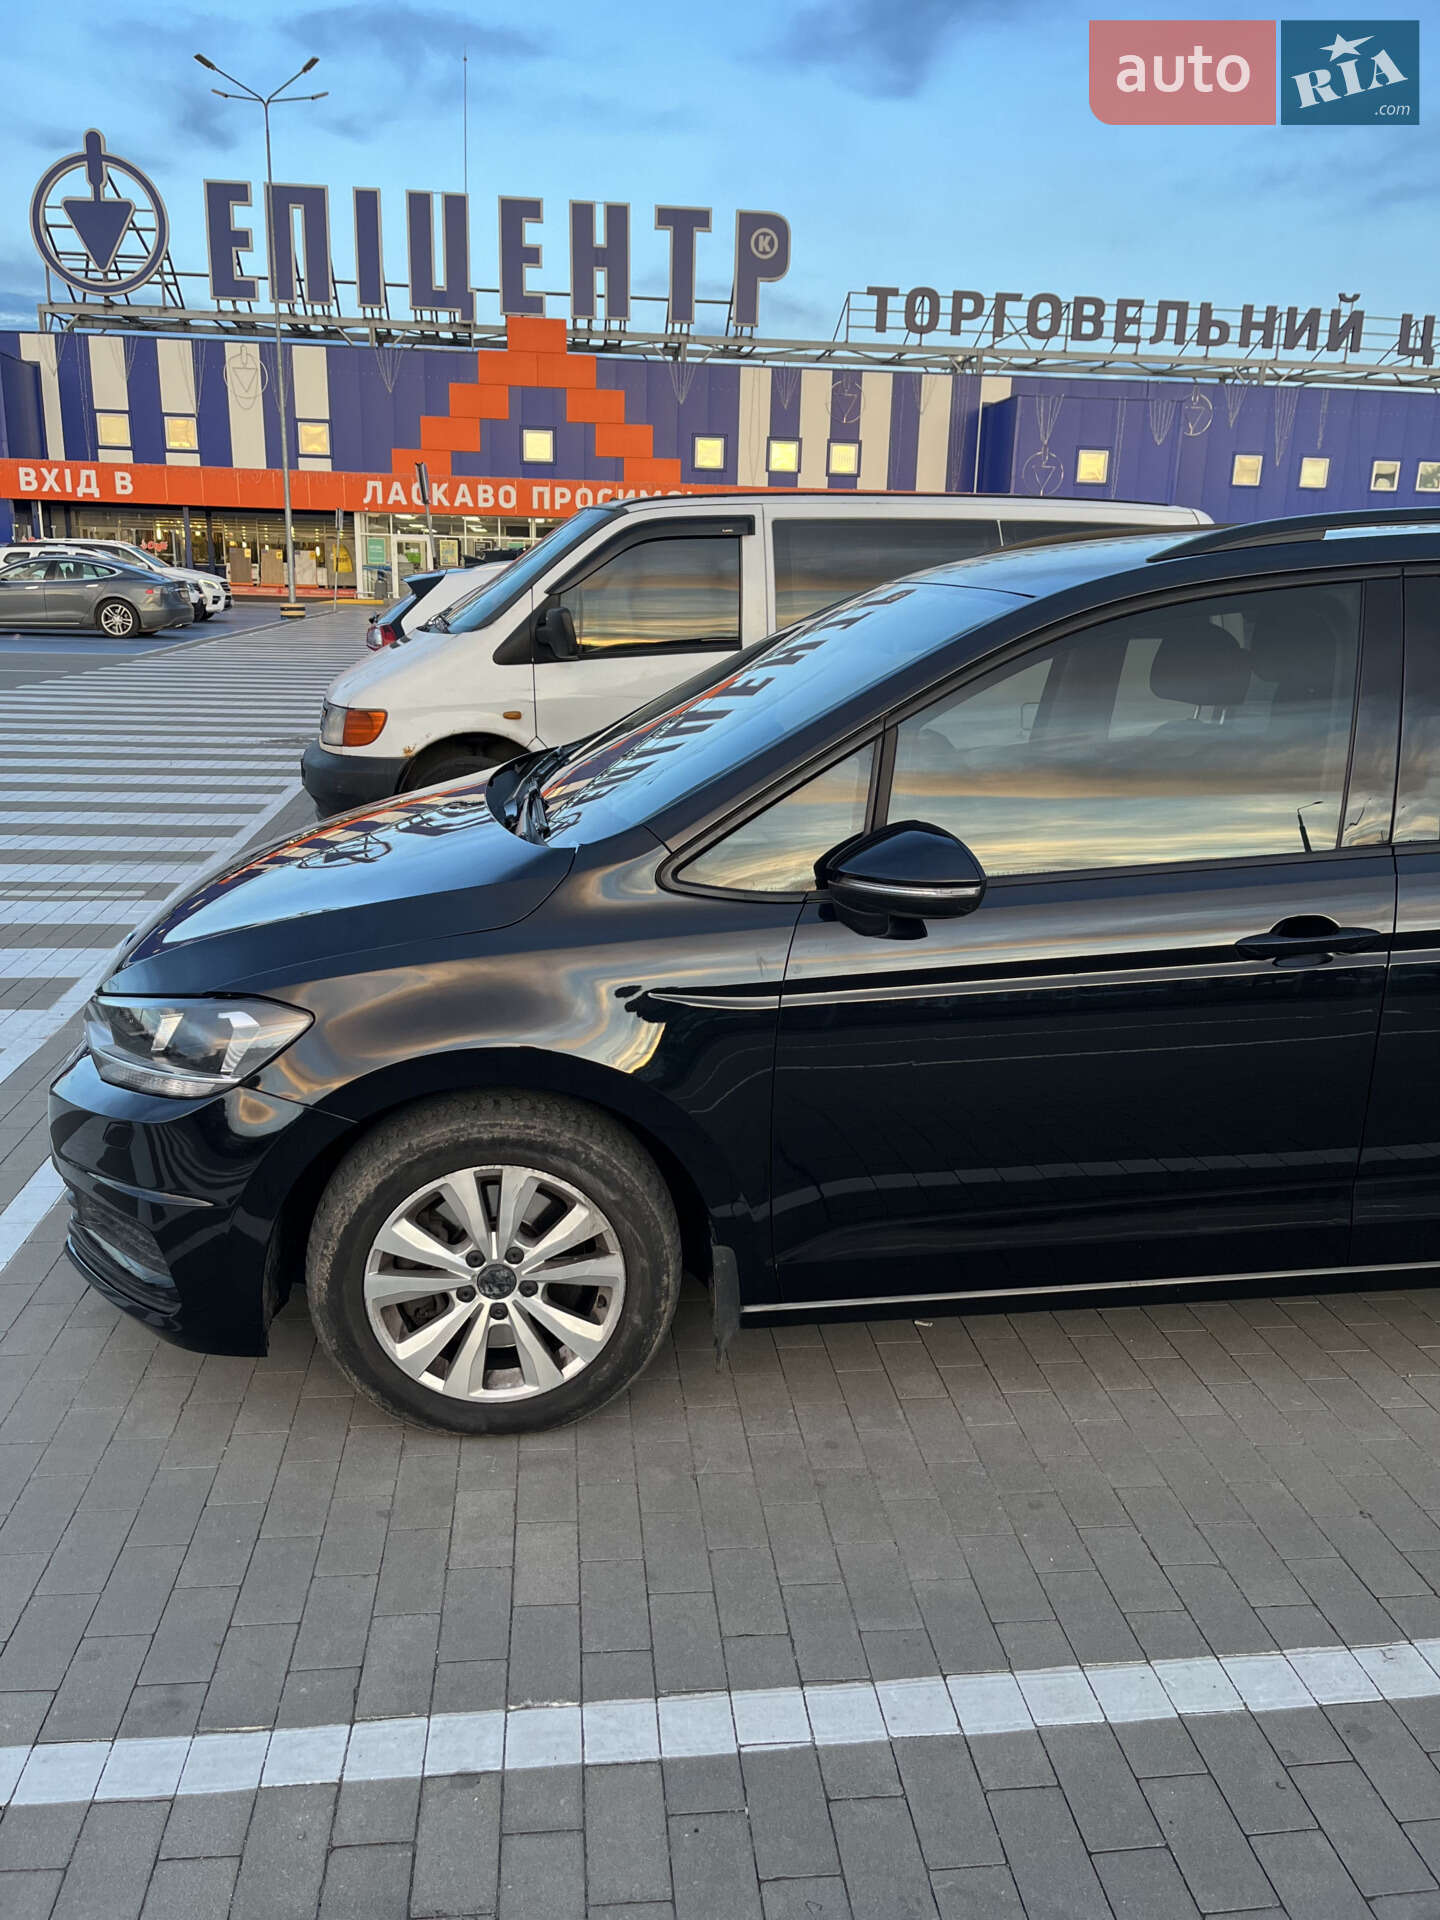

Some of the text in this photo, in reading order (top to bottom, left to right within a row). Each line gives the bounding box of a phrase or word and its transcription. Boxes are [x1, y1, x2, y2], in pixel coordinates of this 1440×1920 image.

[203, 179, 791, 328] ЕПІЦЕНТР
[866, 286, 1366, 353] ТОРГОВЕЛЬНИЙ
[18, 466, 134, 498] ВХІД В
[362, 480, 518, 509] ЛАСКАВО
